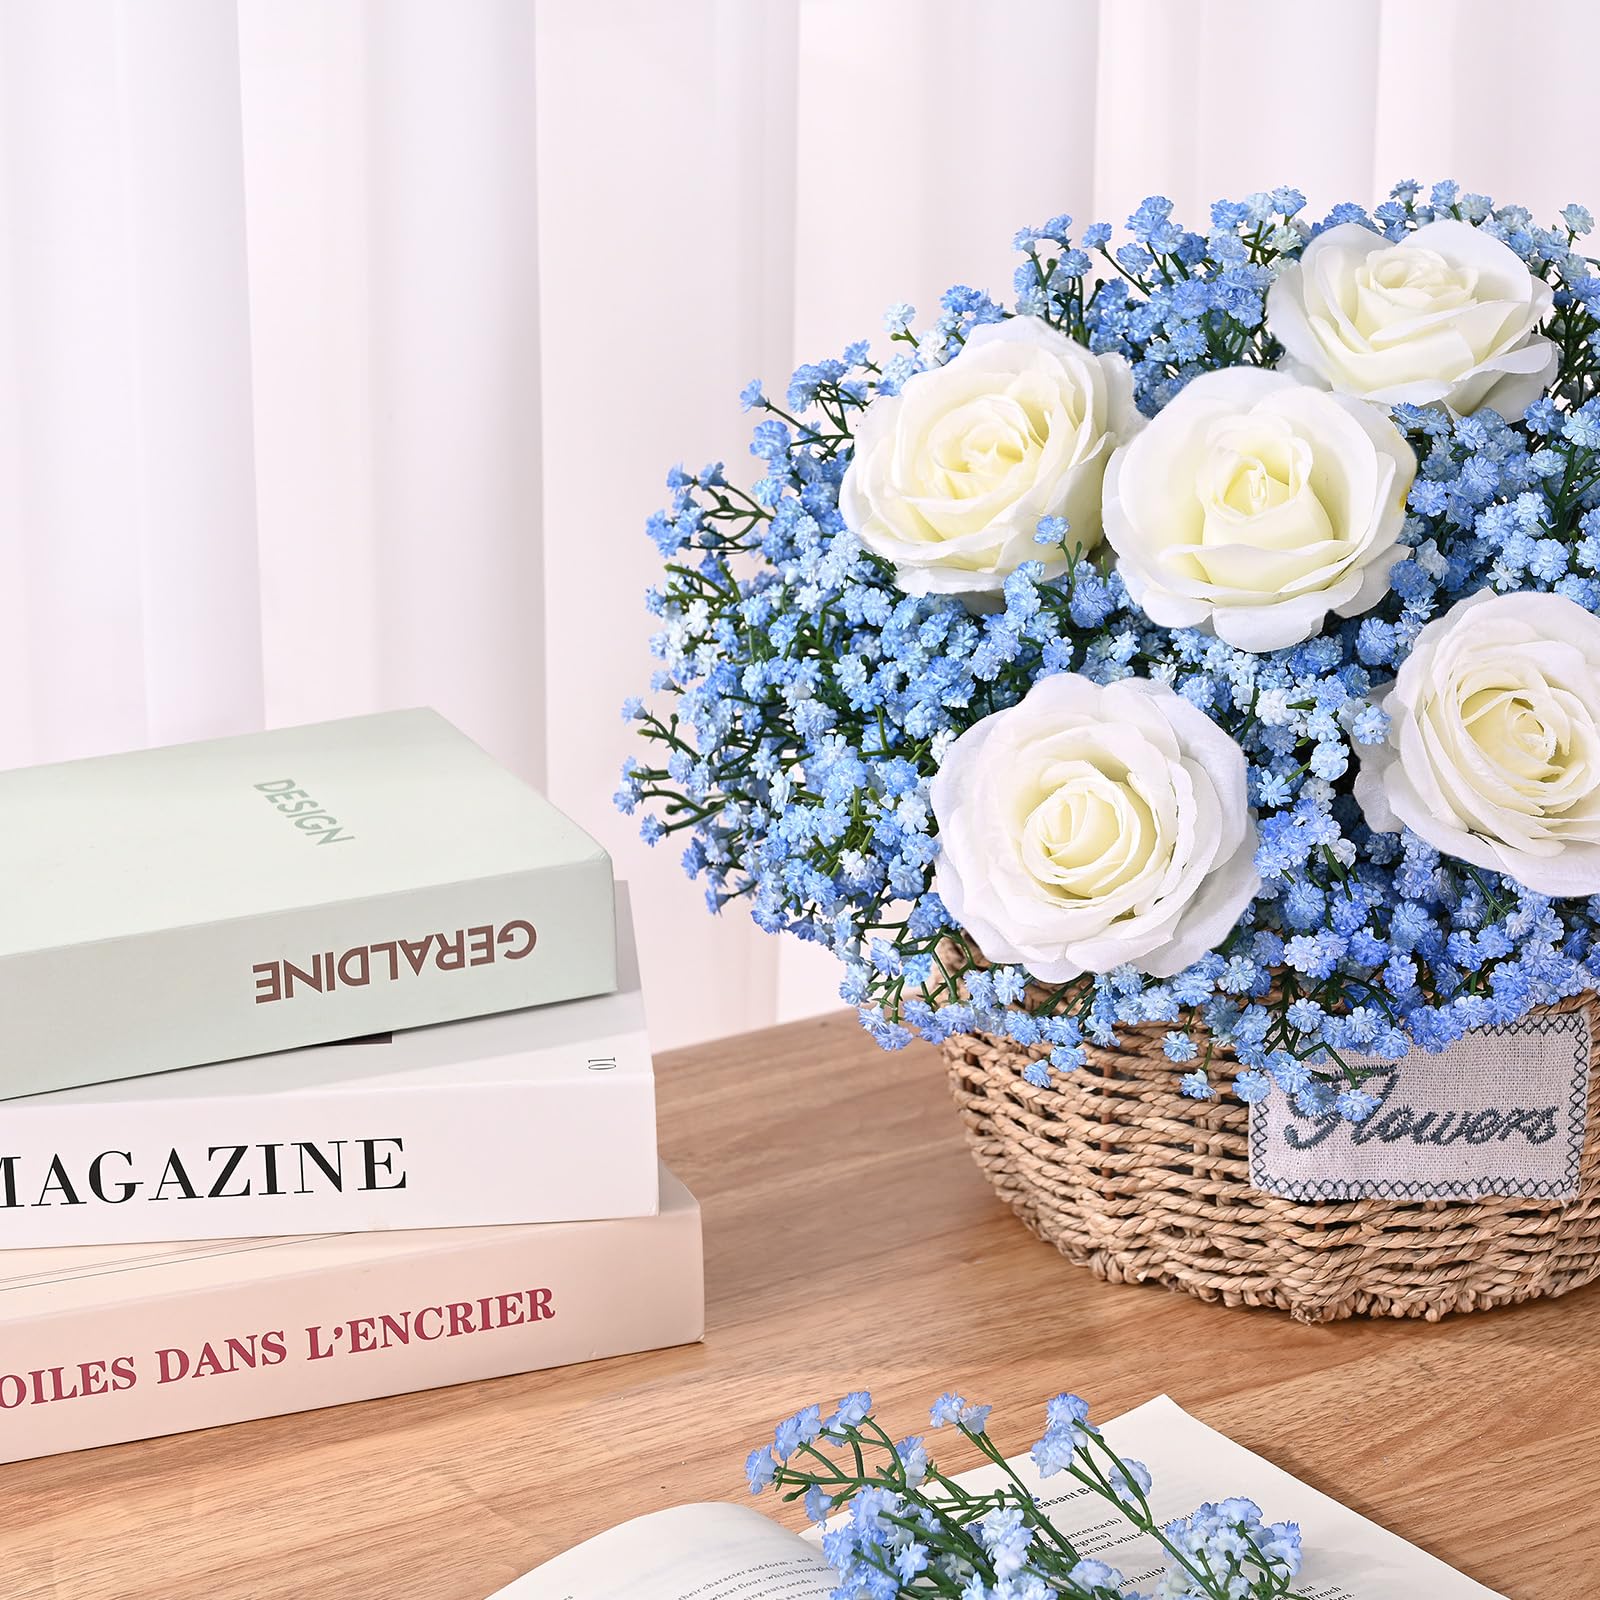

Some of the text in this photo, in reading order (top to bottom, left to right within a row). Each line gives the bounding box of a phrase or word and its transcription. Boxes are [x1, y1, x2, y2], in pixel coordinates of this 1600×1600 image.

[253, 778, 355, 846] DESIGN
[252, 919, 538, 1004] GERALDINE
[156, 1331, 288, 1385] DANS
[306, 1287, 557, 1361] L’ENCRIER
[1034, 1492, 1079, 1510] easant
[1093, 1517, 1122, 1531] each)
[1074, 1531, 1112, 1548] egrees)
[1114, 1532, 1144, 1545] white
[702, 1569, 747, 1590] character
